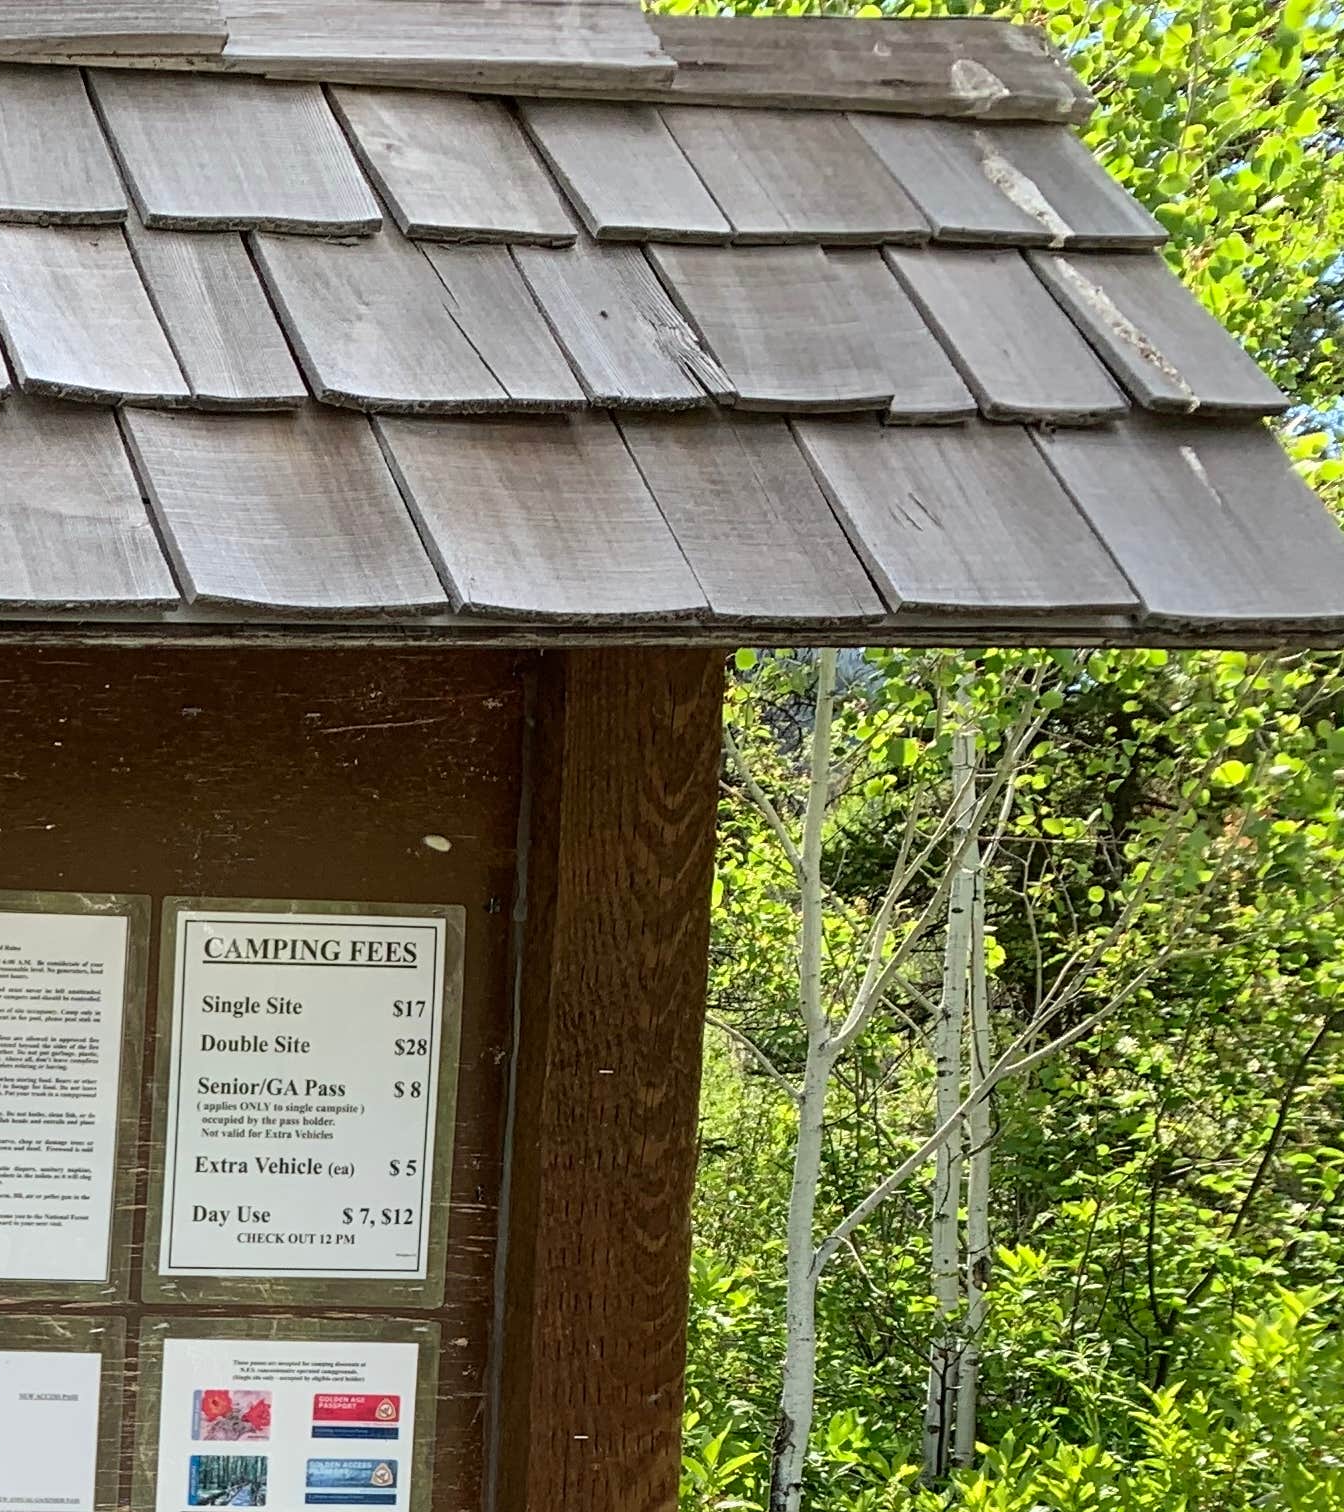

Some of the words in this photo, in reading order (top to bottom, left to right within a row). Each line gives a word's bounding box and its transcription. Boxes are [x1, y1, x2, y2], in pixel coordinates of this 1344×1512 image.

[203, 937, 341, 961] CAMPING
[350, 941, 417, 964] FEES
[201, 995, 261, 1018] Single
[266, 997, 303, 1015] Site
[392, 1000, 426, 1018] $17
[201, 1034, 269, 1053] Double
[274, 1036, 311, 1054] Site
[394, 1039, 428, 1056] $28
[197, 1077, 299, 1096] Senior/GA
[305, 1080, 346, 1097] Pass
[202, 1116, 245, 1127] occupied
[247, 1115, 259, 1127] by
[261, 1116, 277, 1126] the
[279, 1118, 300, 1129] pass
[302, 1116, 335, 1127] holder.
[195, 1156, 248, 1174] Extra
[255, 1157, 323, 1175] Vehicle
[328, 1162, 355, 1177] (ea)
[192, 1205, 230, 1228] Day
[237, 1206, 271, 1223] Use
[381, 1208, 414, 1226] $12
[237, 1232, 284, 1244] CHECK
[288, 1233, 316, 1245] OUT
[320, 1233, 332, 1245] 12
[335, 1234, 355, 1245] PM
